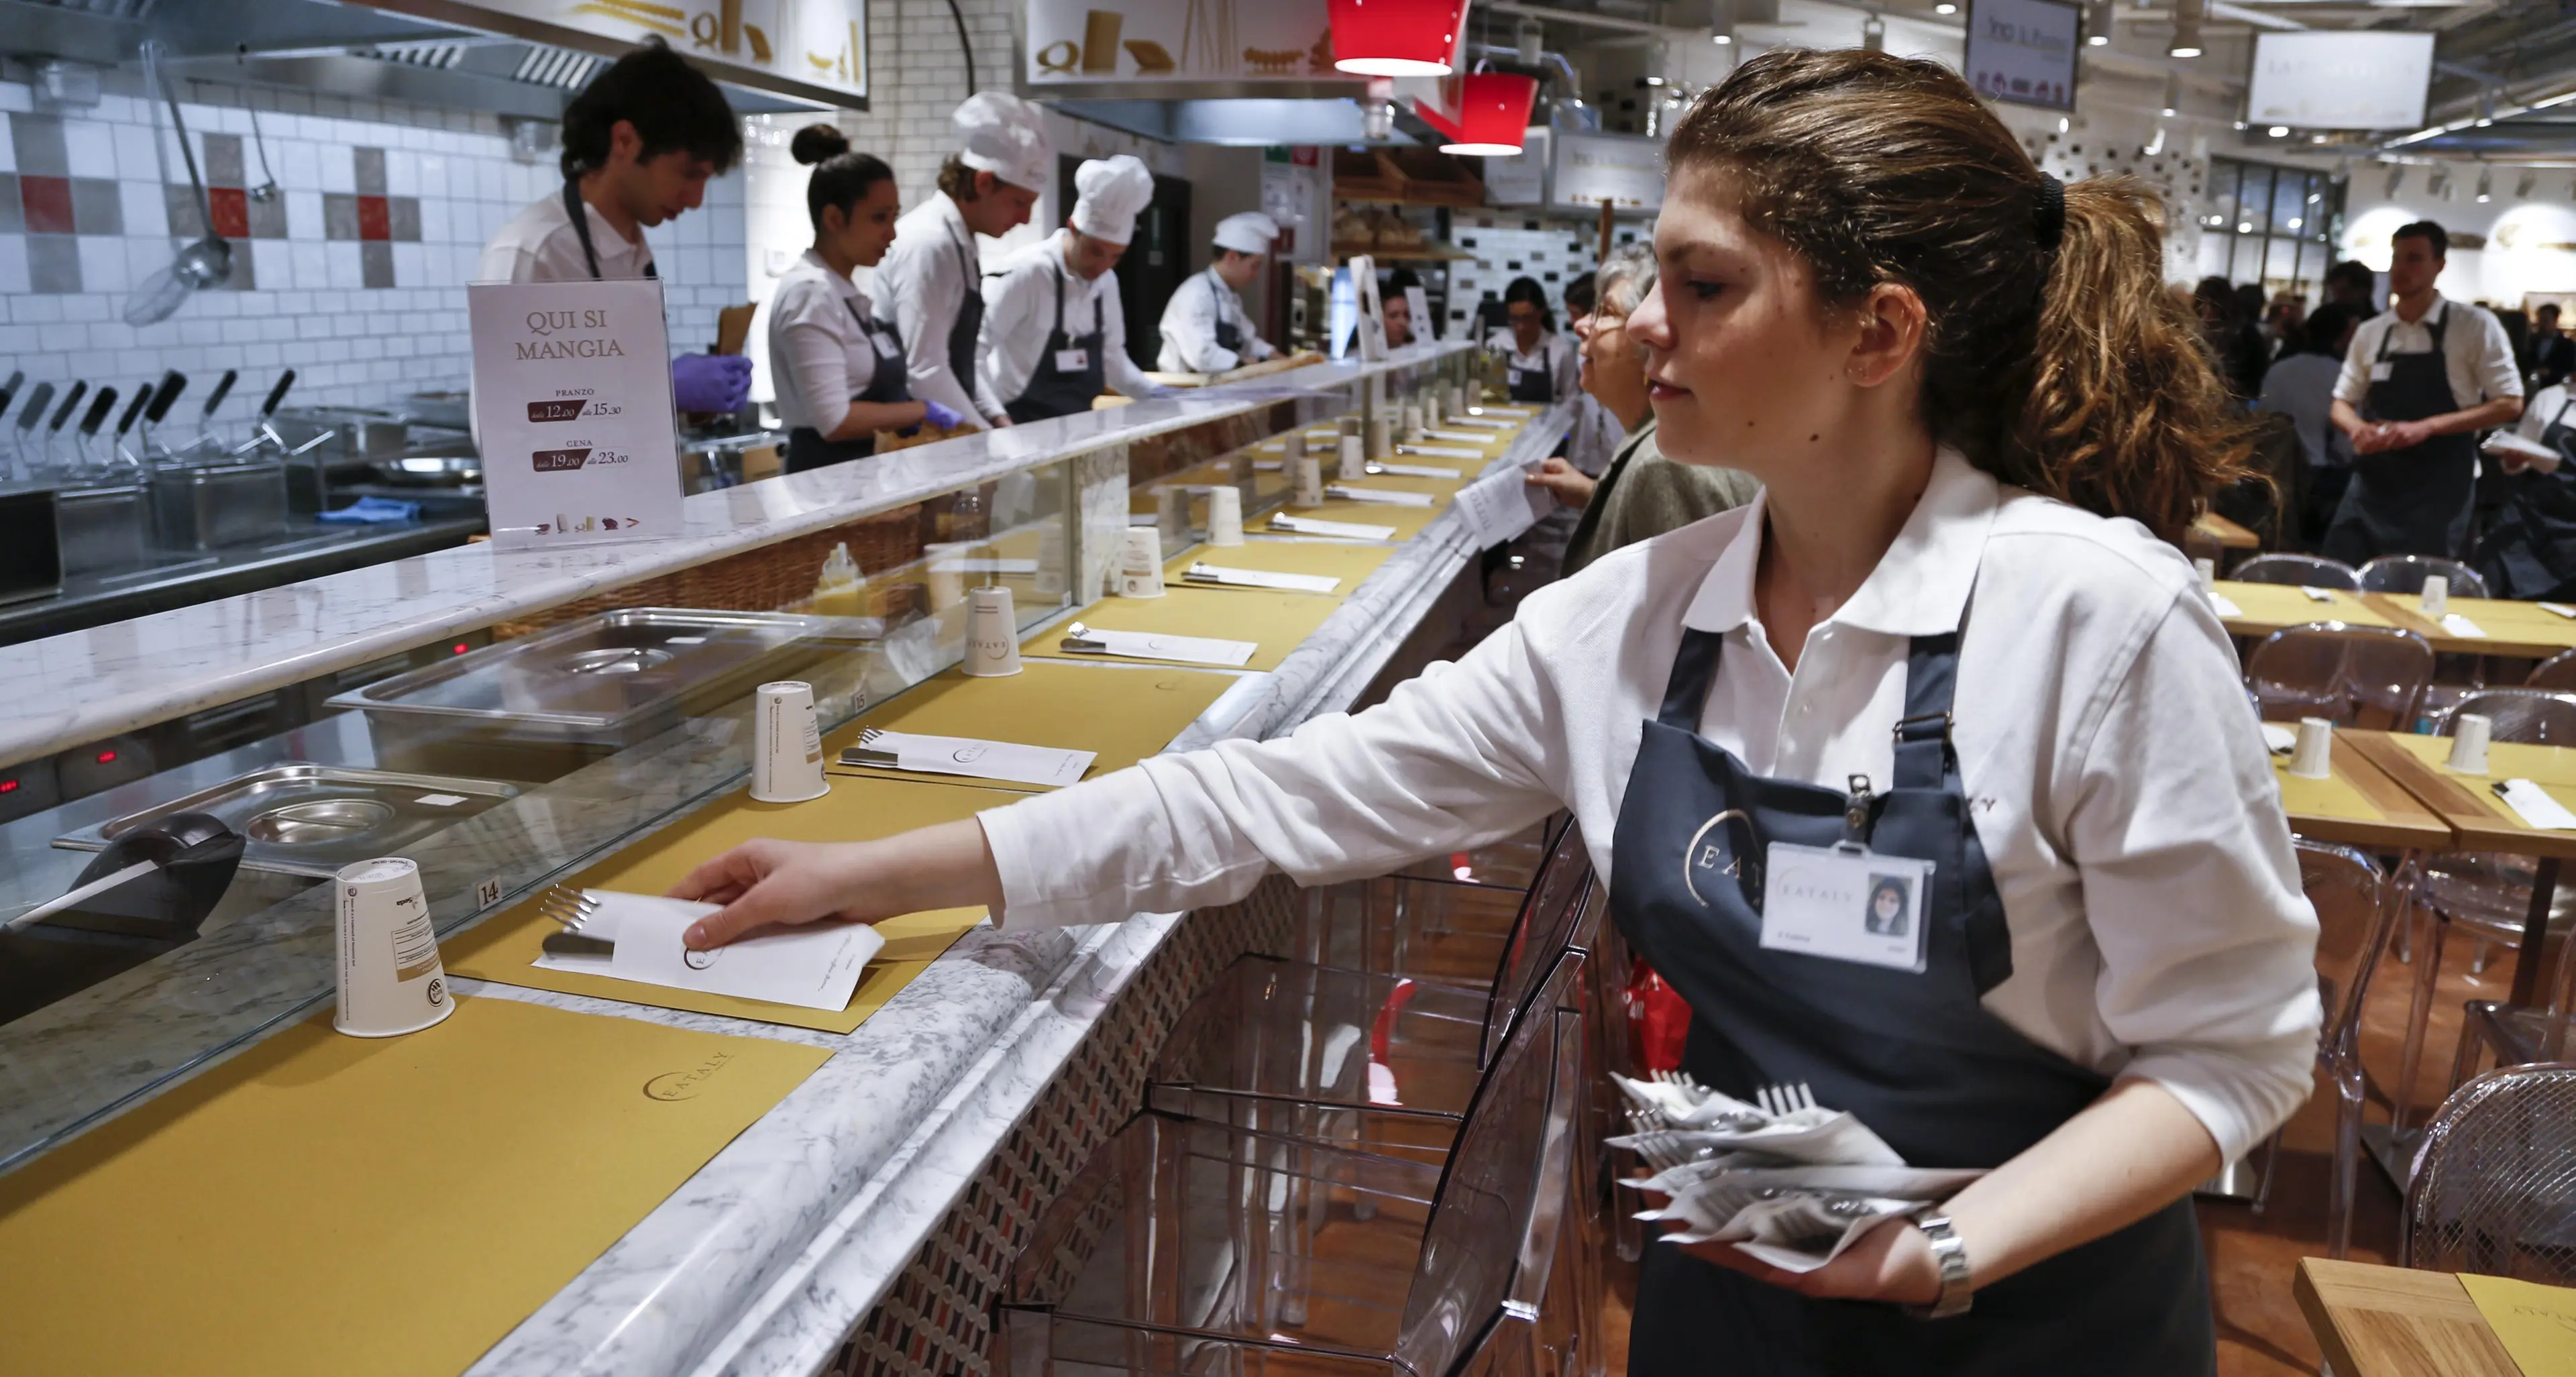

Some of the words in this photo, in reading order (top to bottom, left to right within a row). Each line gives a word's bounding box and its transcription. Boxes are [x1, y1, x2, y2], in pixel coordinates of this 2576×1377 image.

[527, 310, 577, 335] QUI
[585, 310, 607, 329] SI
[515, 339, 625, 360] MANGIA
[555, 388, 594, 397] PRANZO
[546, 405, 575, 418] 12.00
[582, 408, 592, 416] alle
[593, 402, 621, 416] 15.30
[551, 454, 580, 467] 19.00
[587, 457, 597, 465] alle
[598, 451, 629, 464] 23.00
[855, 694, 865, 710] 15
[480, 881, 498, 905] 14
[1783, 883, 1853, 903] EATALY
[396, 897, 413, 906] Seda
[661, 1052, 728, 1097] EATALY
[2513, 1307, 2576, 1323] ATALY
